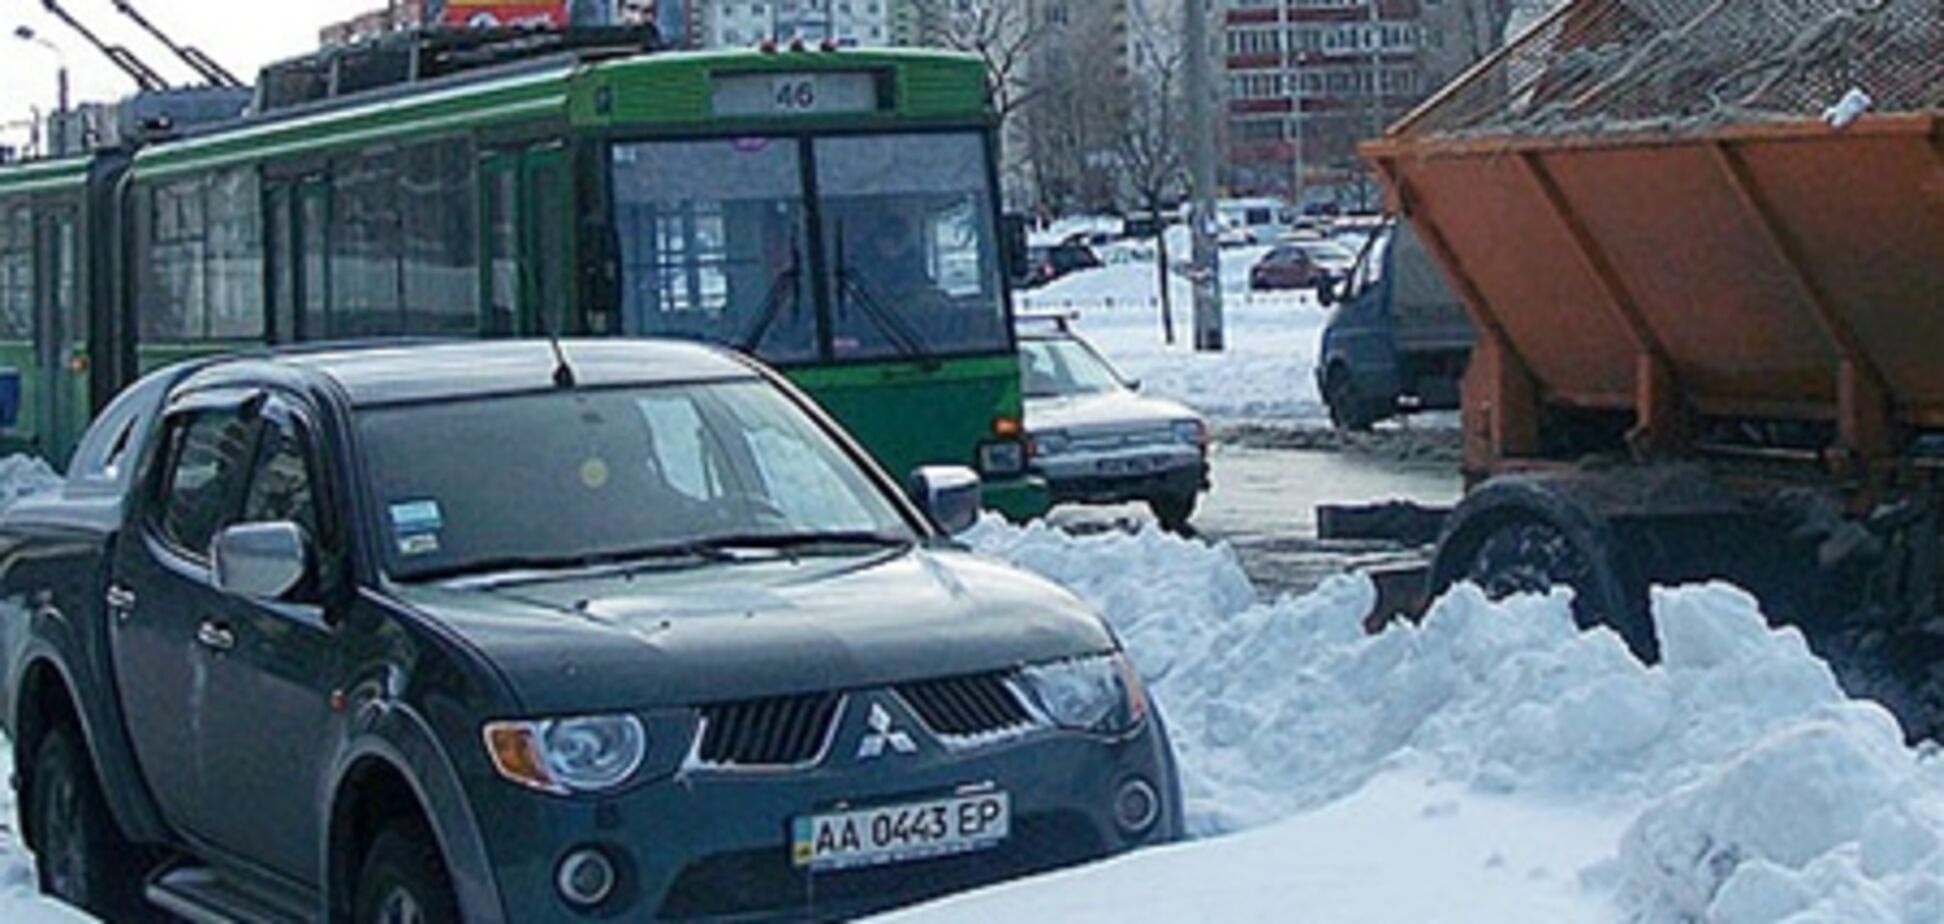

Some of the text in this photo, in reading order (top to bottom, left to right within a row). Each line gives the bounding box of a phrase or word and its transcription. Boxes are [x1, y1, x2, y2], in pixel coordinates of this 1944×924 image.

[776, 82, 814, 109] 46
[816, 799, 1001, 852] AA 0443 EP
